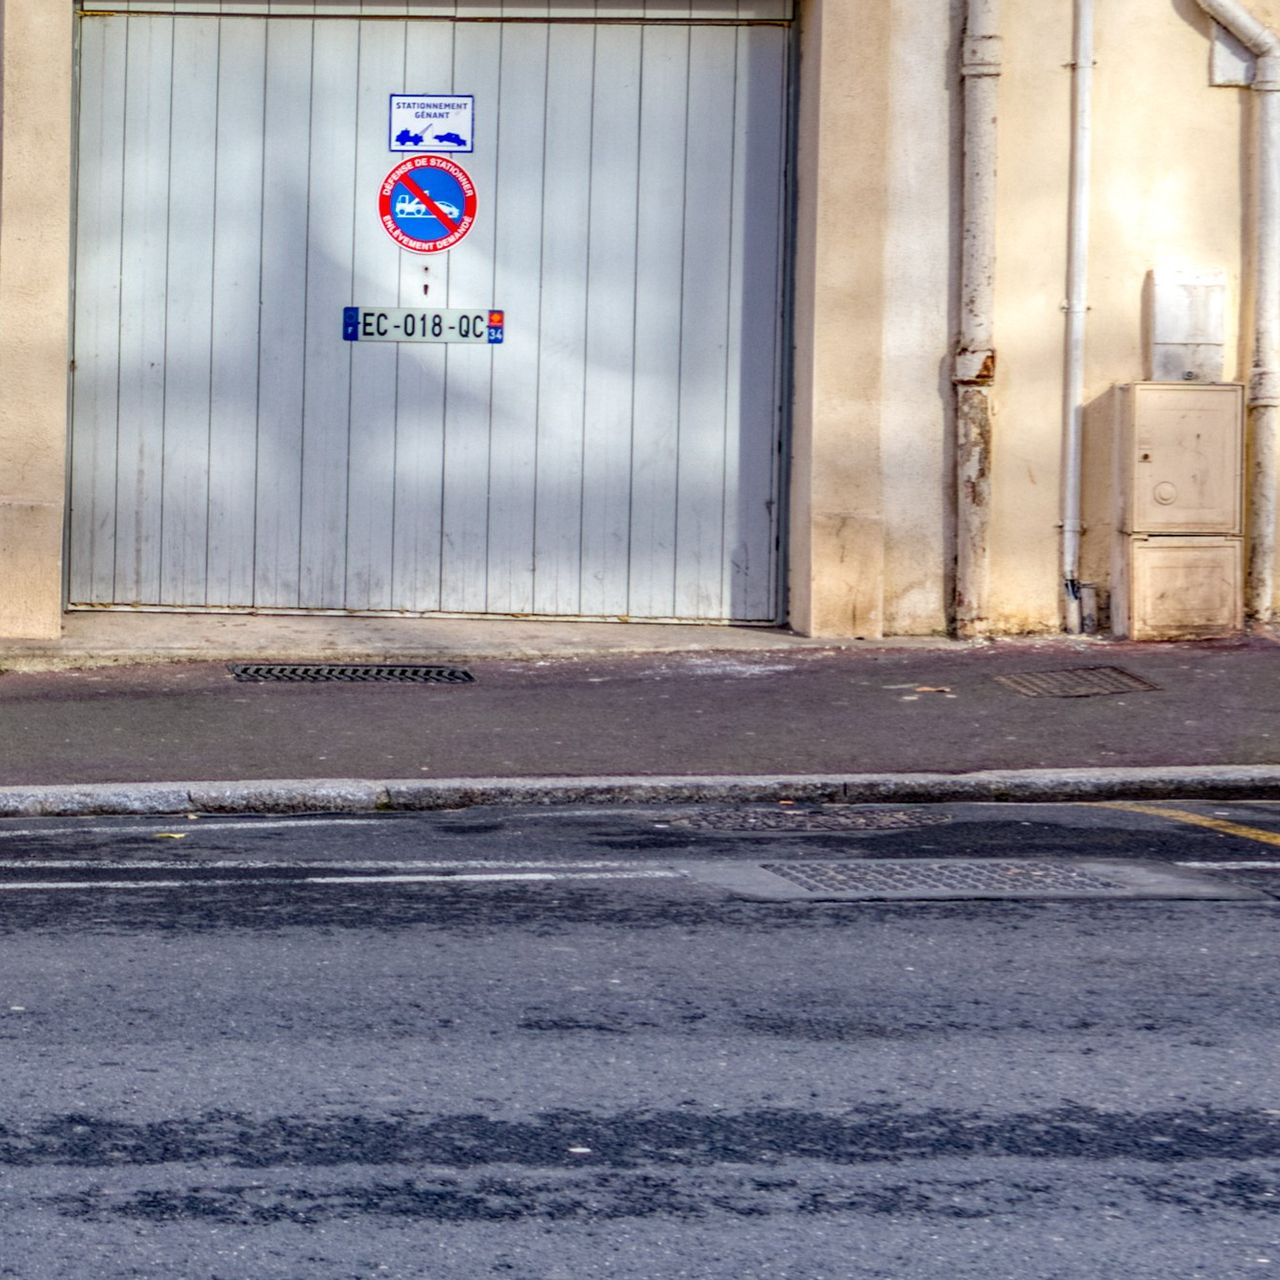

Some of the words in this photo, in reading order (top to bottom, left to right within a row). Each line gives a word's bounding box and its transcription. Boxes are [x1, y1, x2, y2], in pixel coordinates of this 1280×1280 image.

[396, 101, 468, 110] STATIONNEMENT
[382, 161, 414, 196] DÉFENSE
[414, 157, 428, 167] DE
[429, 157, 474, 197] STATIONNER
[382, 214, 435, 250] ENLÈVEMENT
[347, 326, 354, 334] F
[362, 312, 484, 338] EC-018-QC
[489, 328, 503, 339] 34
